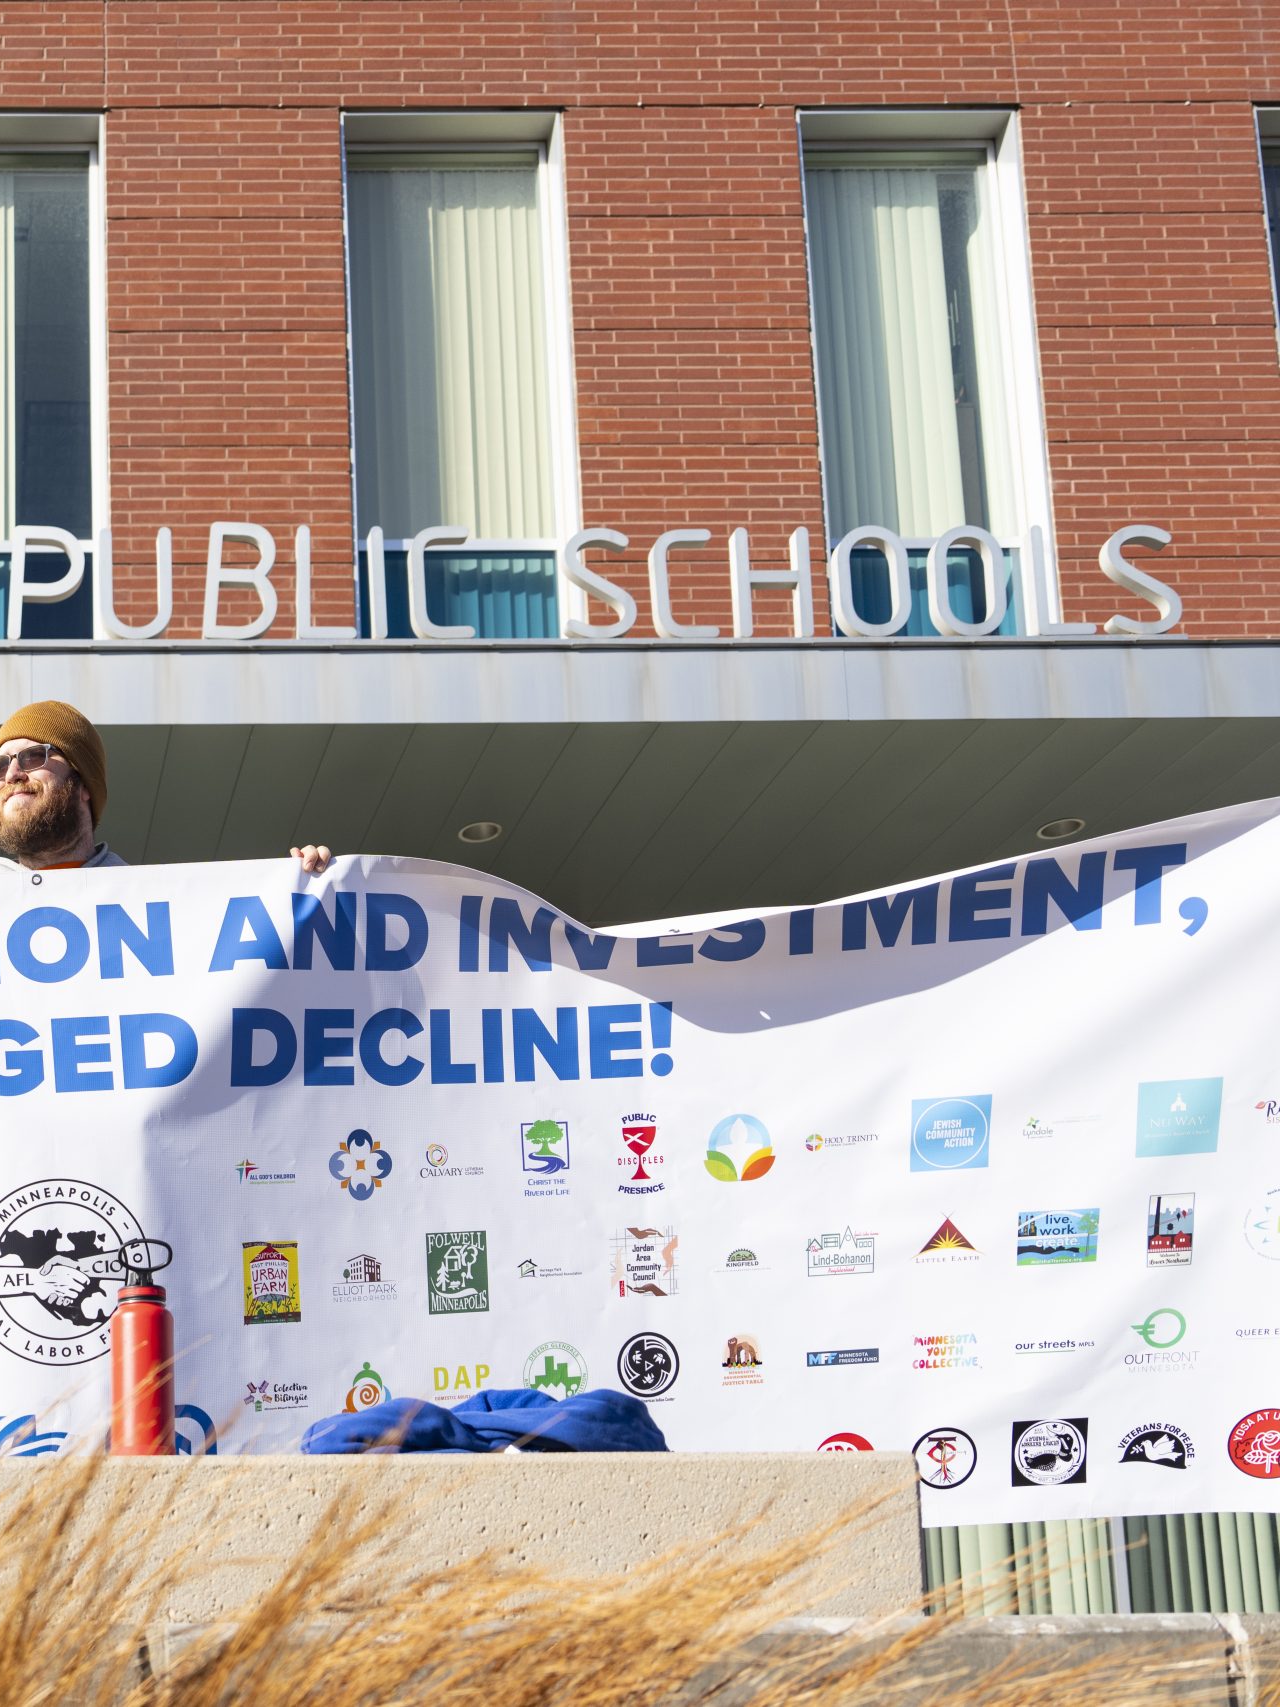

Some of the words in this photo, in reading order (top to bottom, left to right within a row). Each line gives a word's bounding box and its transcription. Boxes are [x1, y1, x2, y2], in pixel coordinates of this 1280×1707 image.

[8, 524, 476, 640] PUBLIC
[561, 524, 1184, 638] SCHOOLS
[208, 892, 430, 973] AND
[230, 1000, 675, 1087] DECLINE!
[621, 1113, 657, 1125] PUBLIC
[933, 1119, 961, 1130] JEWISH
[926, 1128, 976, 1140] COMMUNITY
[1023, 1126, 1053, 1139] Lyndale
[825, 1136, 844, 1144] HOLY
[847, 1134, 880, 1142] TRINITY
[944, 1138, 974, 1148] ACTION
[420, 1167, 463, 1179] CALVARY
[618, 1183, 665, 1195] PRESENCE
[1045, 1214, 1073, 1225] live.
[1039, 1225, 1077, 1237] work.
[427, 1232, 485, 1254] FOLWELL
[632, 1244, 655, 1253] Jordan
[636, 1253, 651, 1262] Area
[813, 1253, 871, 1266] Lind-Bohanon
[916, 1255, 946, 1264] LITTLE
[951, 1254, 980, 1263] EARTH
[626, 1262, 662, 1274] Community
[726, 1260, 759, 1268] KINGFIELD
[3, 1274, 34, 1287] AFL
[252, 1268, 287, 1282] URBAN
[633, 1272, 656, 1282] Council
[254, 1281, 286, 1295] FARM
[333, 1284, 364, 1296] ELLIOT
[368, 1283, 397, 1294] PARK
[333, 1294, 398, 1303] NEIGHBORHOOD
[430, 1289, 487, 1312] MINNEAPOLIS
[1235, 1328, 1270, 1337] QUEER
[24, 1340, 85, 1358] LABOR
[1015, 1341, 1034, 1350] our
[1038, 1339, 1076, 1349] streets
[927, 1345, 964, 1357] YOUTH
[808, 1353, 837, 1366] MFF
[1124, 1350, 1200, 1365] OUTFRONT
[1128, 1363, 1195, 1373] MINNESOTA
[433, 1364, 490, 1391] DAP
[1233, 1419, 1255, 1441] YDSA
[1257, 1412, 1269, 1422] AT
[1118, 1423, 1162, 1450] VETERANS
[1164, 1424, 1181, 1435] FOR
[1179, 1433, 1195, 1459] PEACE
